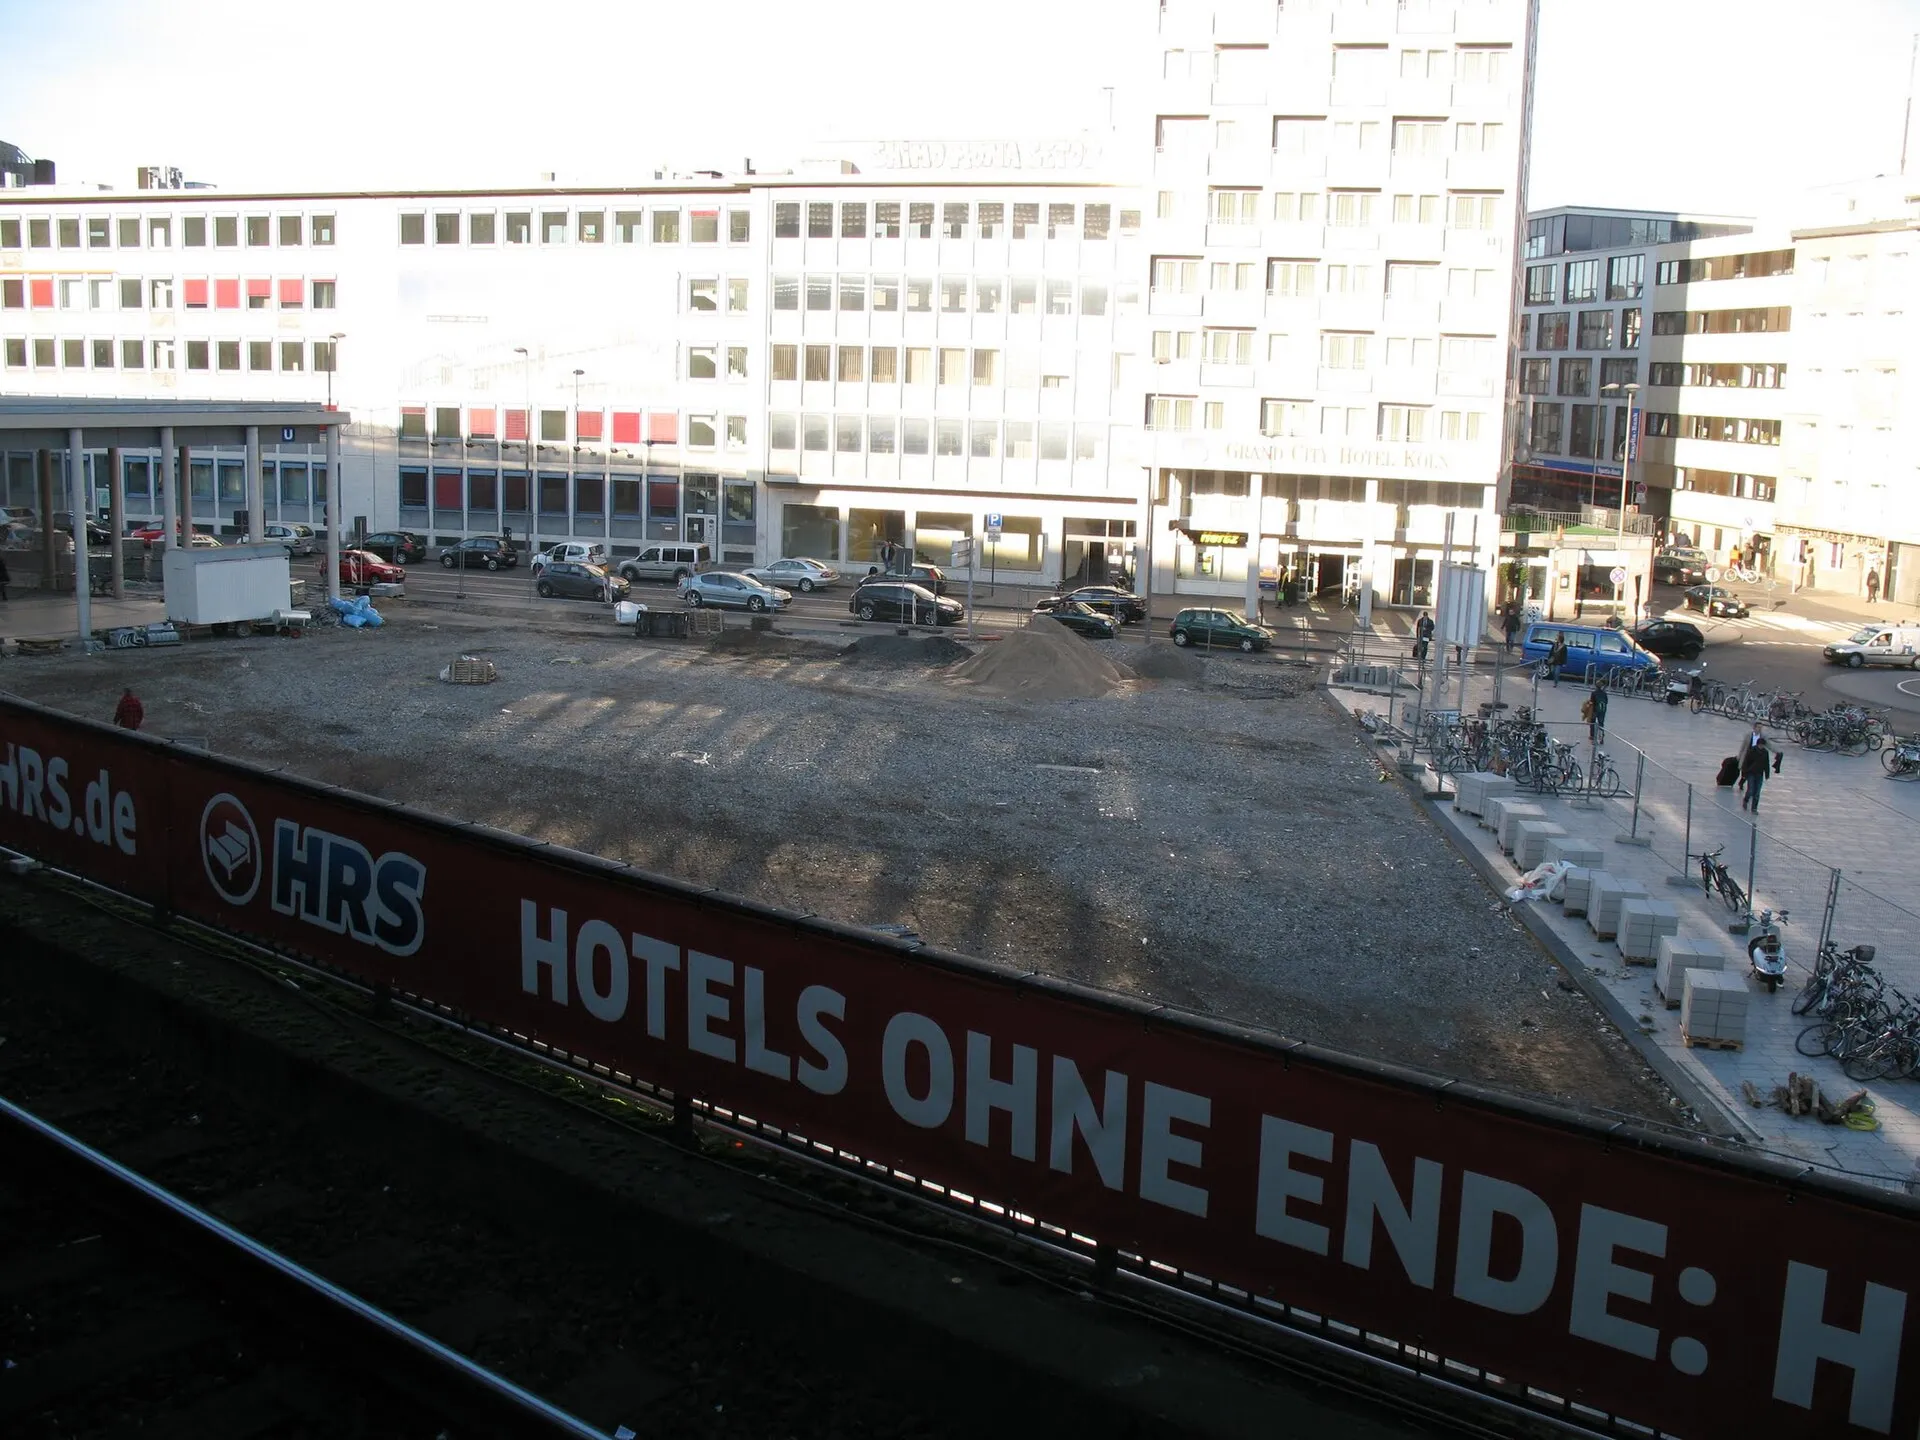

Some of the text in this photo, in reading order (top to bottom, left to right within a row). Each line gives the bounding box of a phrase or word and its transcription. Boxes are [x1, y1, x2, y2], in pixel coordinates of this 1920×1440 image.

[284, 429, 293, 440] U
[990, 514, 999, 525] P
[0, 741, 136, 856] HRS.de
[271, 817, 428, 957] HRS
[520, 897, 1920, 1440] HOTELS OHNE ENDE: H
